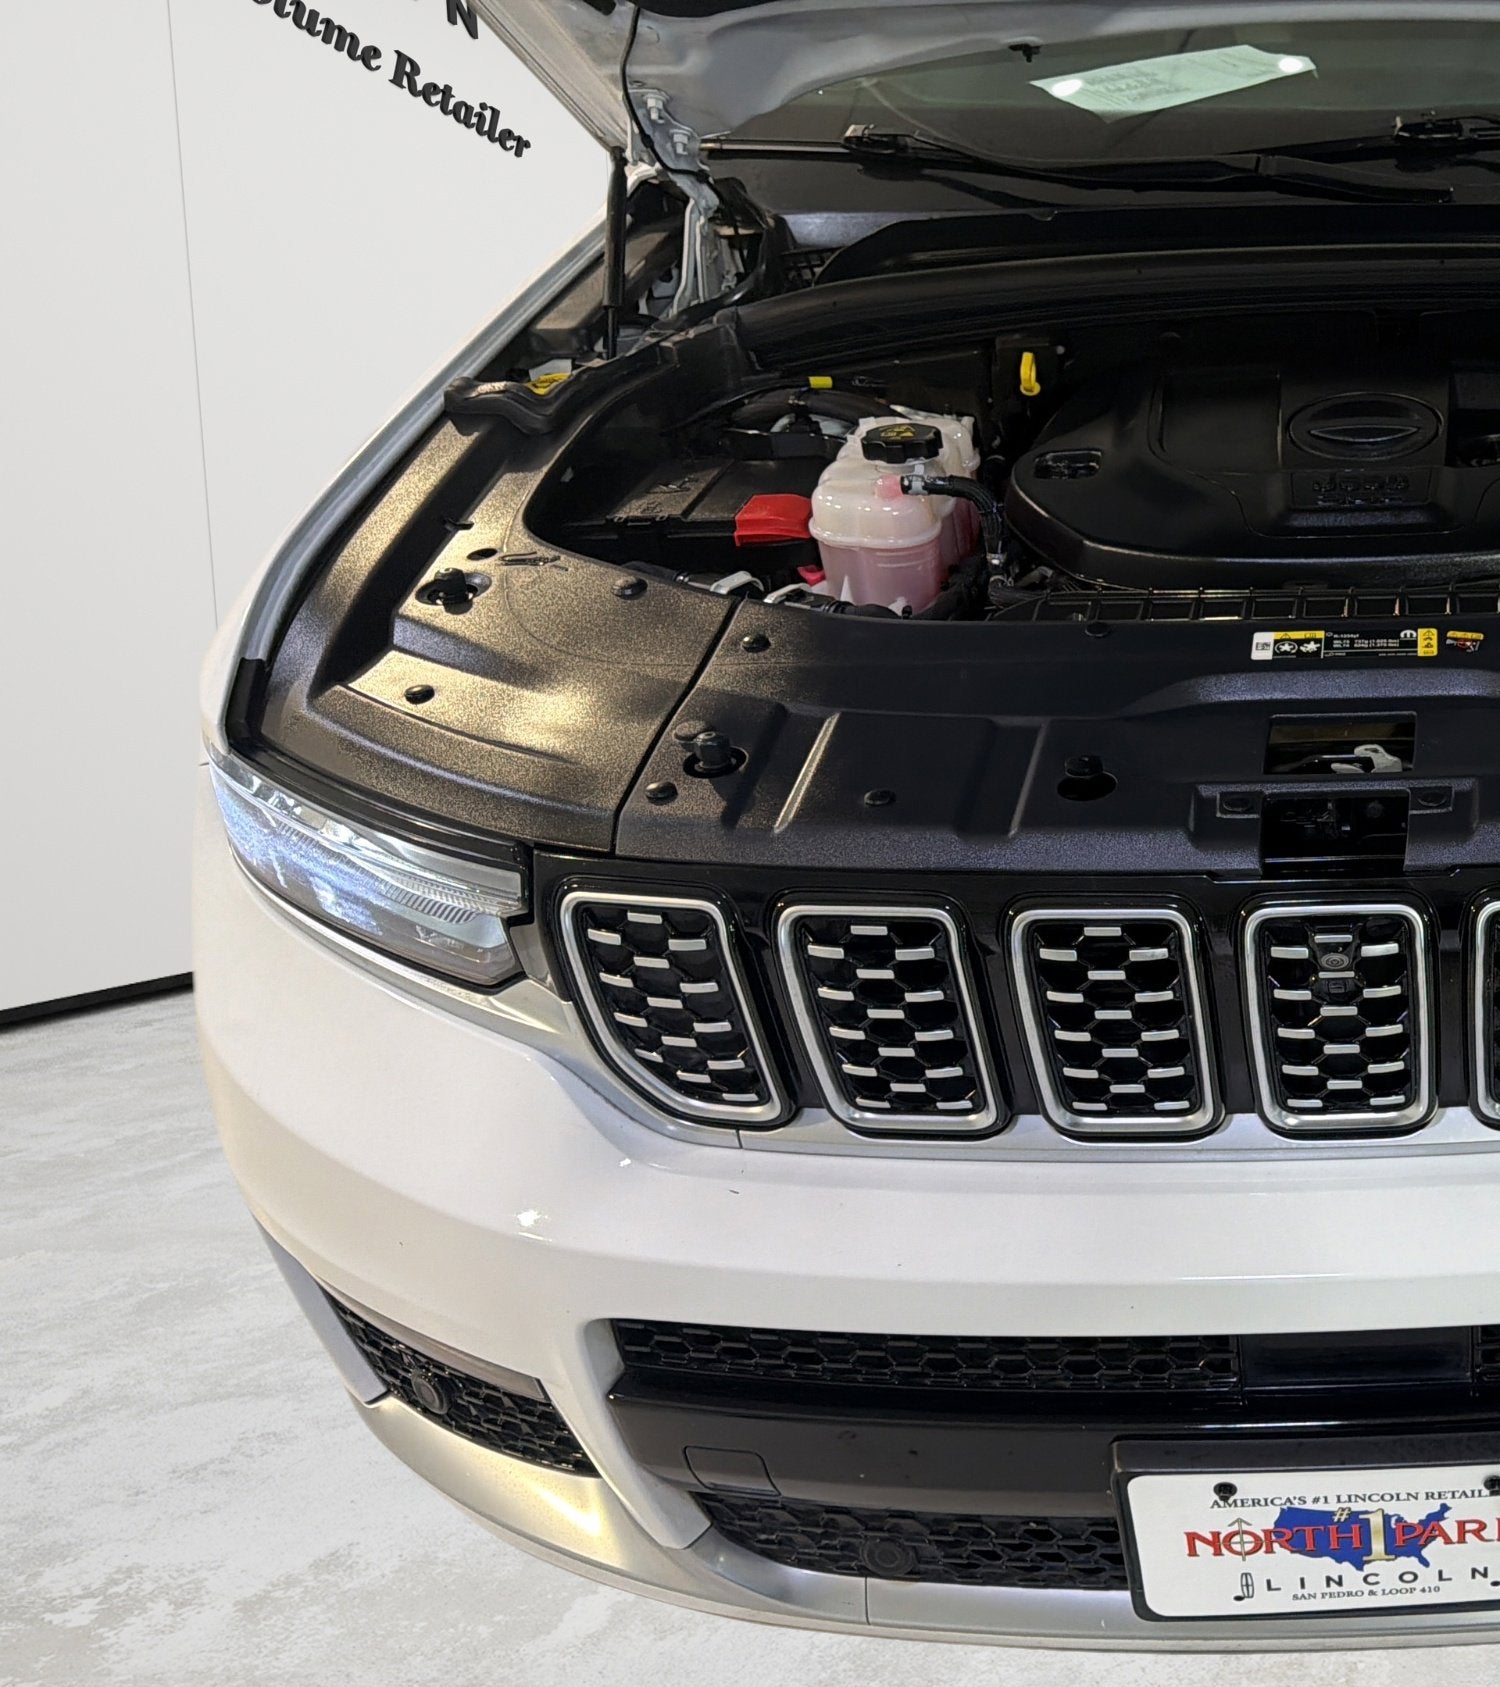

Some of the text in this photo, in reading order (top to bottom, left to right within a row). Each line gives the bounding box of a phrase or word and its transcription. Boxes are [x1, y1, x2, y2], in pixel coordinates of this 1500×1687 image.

[252, 0, 531, 158] ume Retailer
[1210, 1495, 1307, 1508] AMERICA'S
[1312, 1495, 1330, 1504] #1
[1336, 1492, 1419, 1503] LINCOLN
[1184, 1523, 1363, 1557] NORTH
[1266, 1566, 1489, 1592] LINCOLN
[1292, 1585, 1441, 1601] SAN PEDRO & LOOP 410
